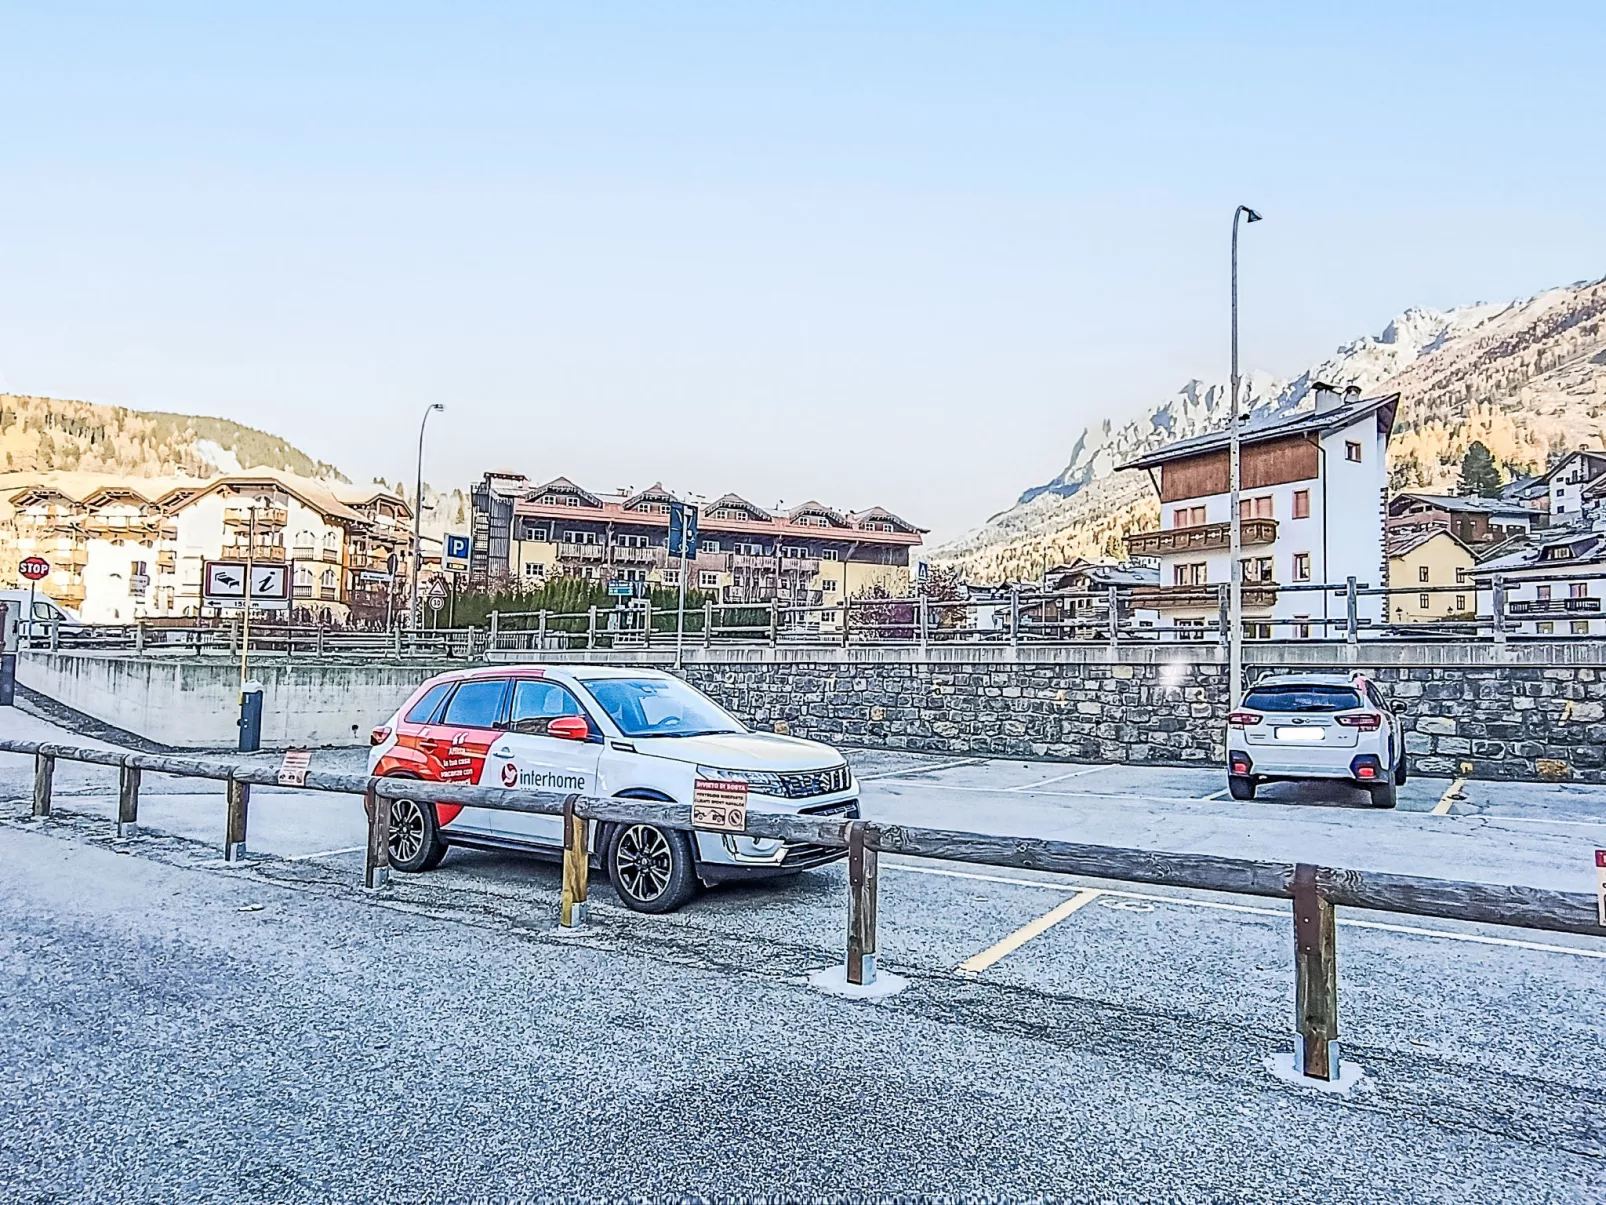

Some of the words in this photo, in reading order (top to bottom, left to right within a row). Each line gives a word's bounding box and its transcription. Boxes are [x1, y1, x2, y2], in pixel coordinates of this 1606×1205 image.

[453, 540, 465, 555] P
[20, 562, 48, 575] STOP
[440, 769, 463, 778] vacanze
[463, 768, 473, 776] con
[520, 768, 585, 790] interhome
[696, 781, 719, 789] DIVIETO
[727, 784, 746, 792] SOSTA
